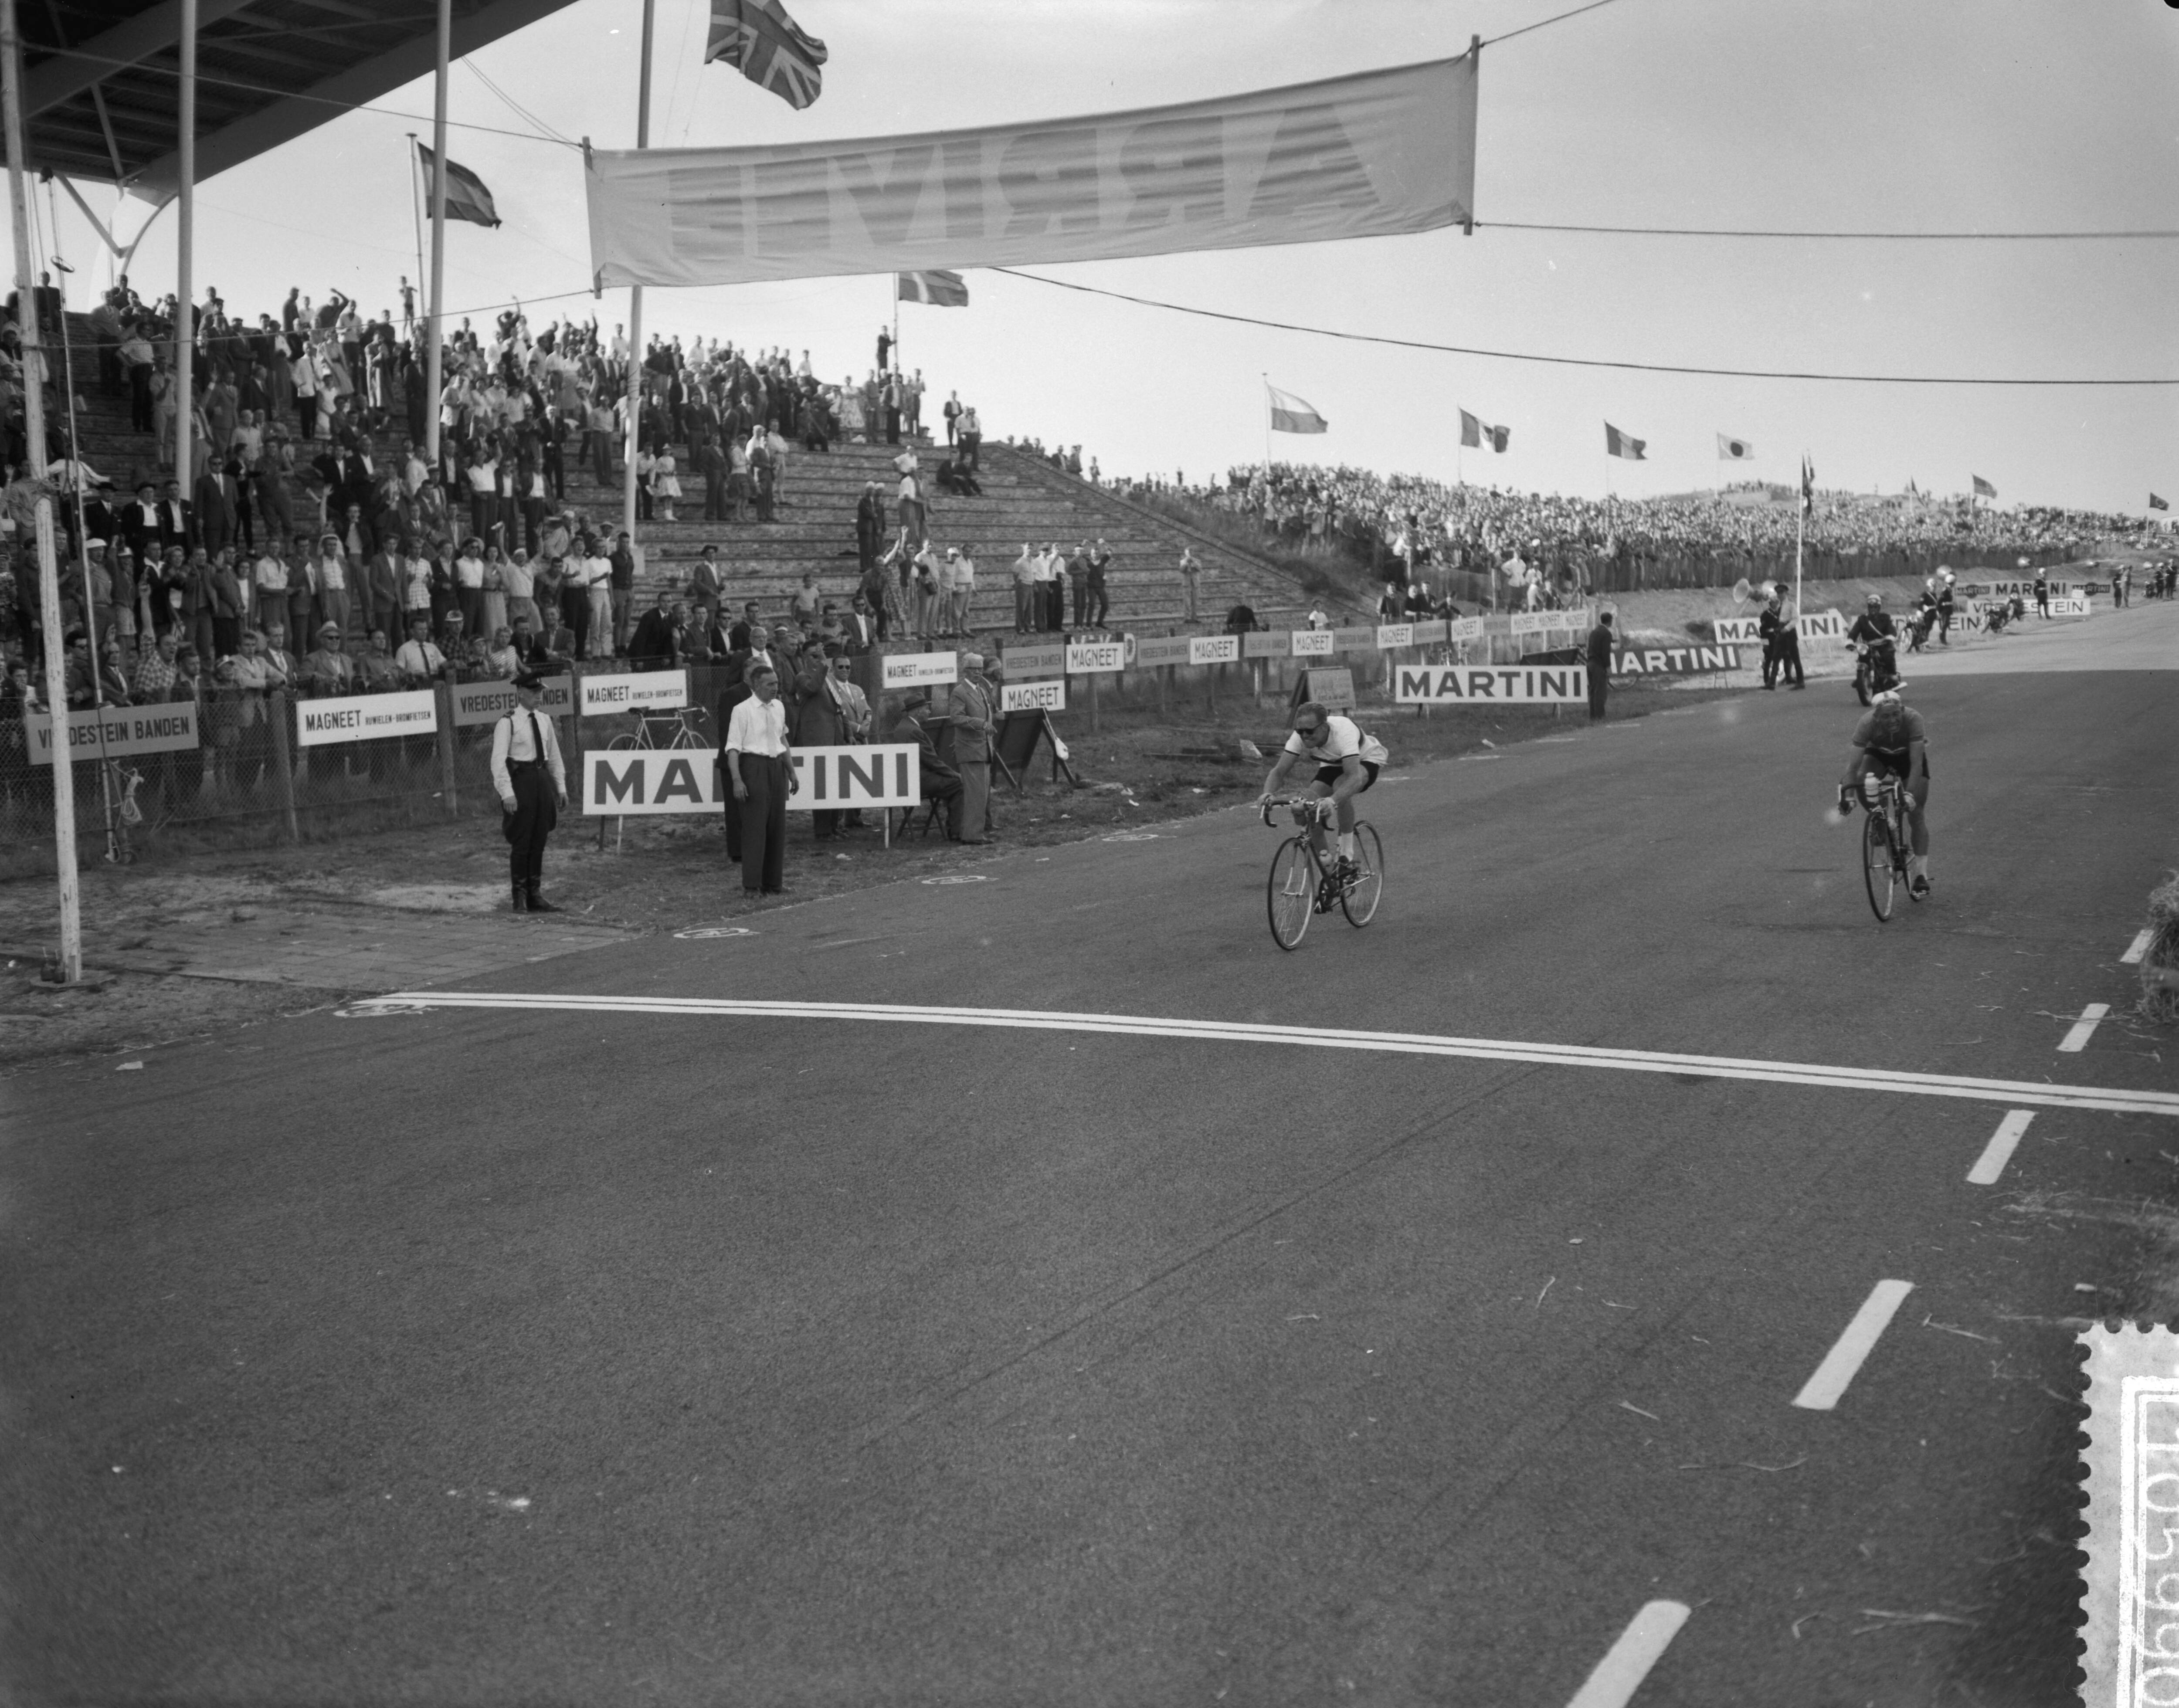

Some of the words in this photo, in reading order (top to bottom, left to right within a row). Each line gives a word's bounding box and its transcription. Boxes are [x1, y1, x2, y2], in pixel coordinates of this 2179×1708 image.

[1996, 583, 2066, 595] MARNI
[1719, 617, 1839, 639] MAINI
[1195, 640, 1234, 659] MAGNEET
[1296, 635, 1329, 651] MAGNEET
[1072, 647, 1118, 668] MAGNEET
[1610, 645, 1737, 674] ARTINI
[887, 664, 917, 678] MAGNEET
[587, 686, 630, 703] MAGNEET
[1402, 671, 1581, 697] MARTINI
[460, 693, 519, 713] VREDESTEI
[540, 688, 568, 706] NDEN
[1008, 686, 1059, 710] MAGNEET
[305, 709, 361, 732] MAGNEET
[38, 722, 129, 749] VDESTEIN
[134, 716, 190, 740] BANDEN
[594, 752, 909, 805] MAINI
